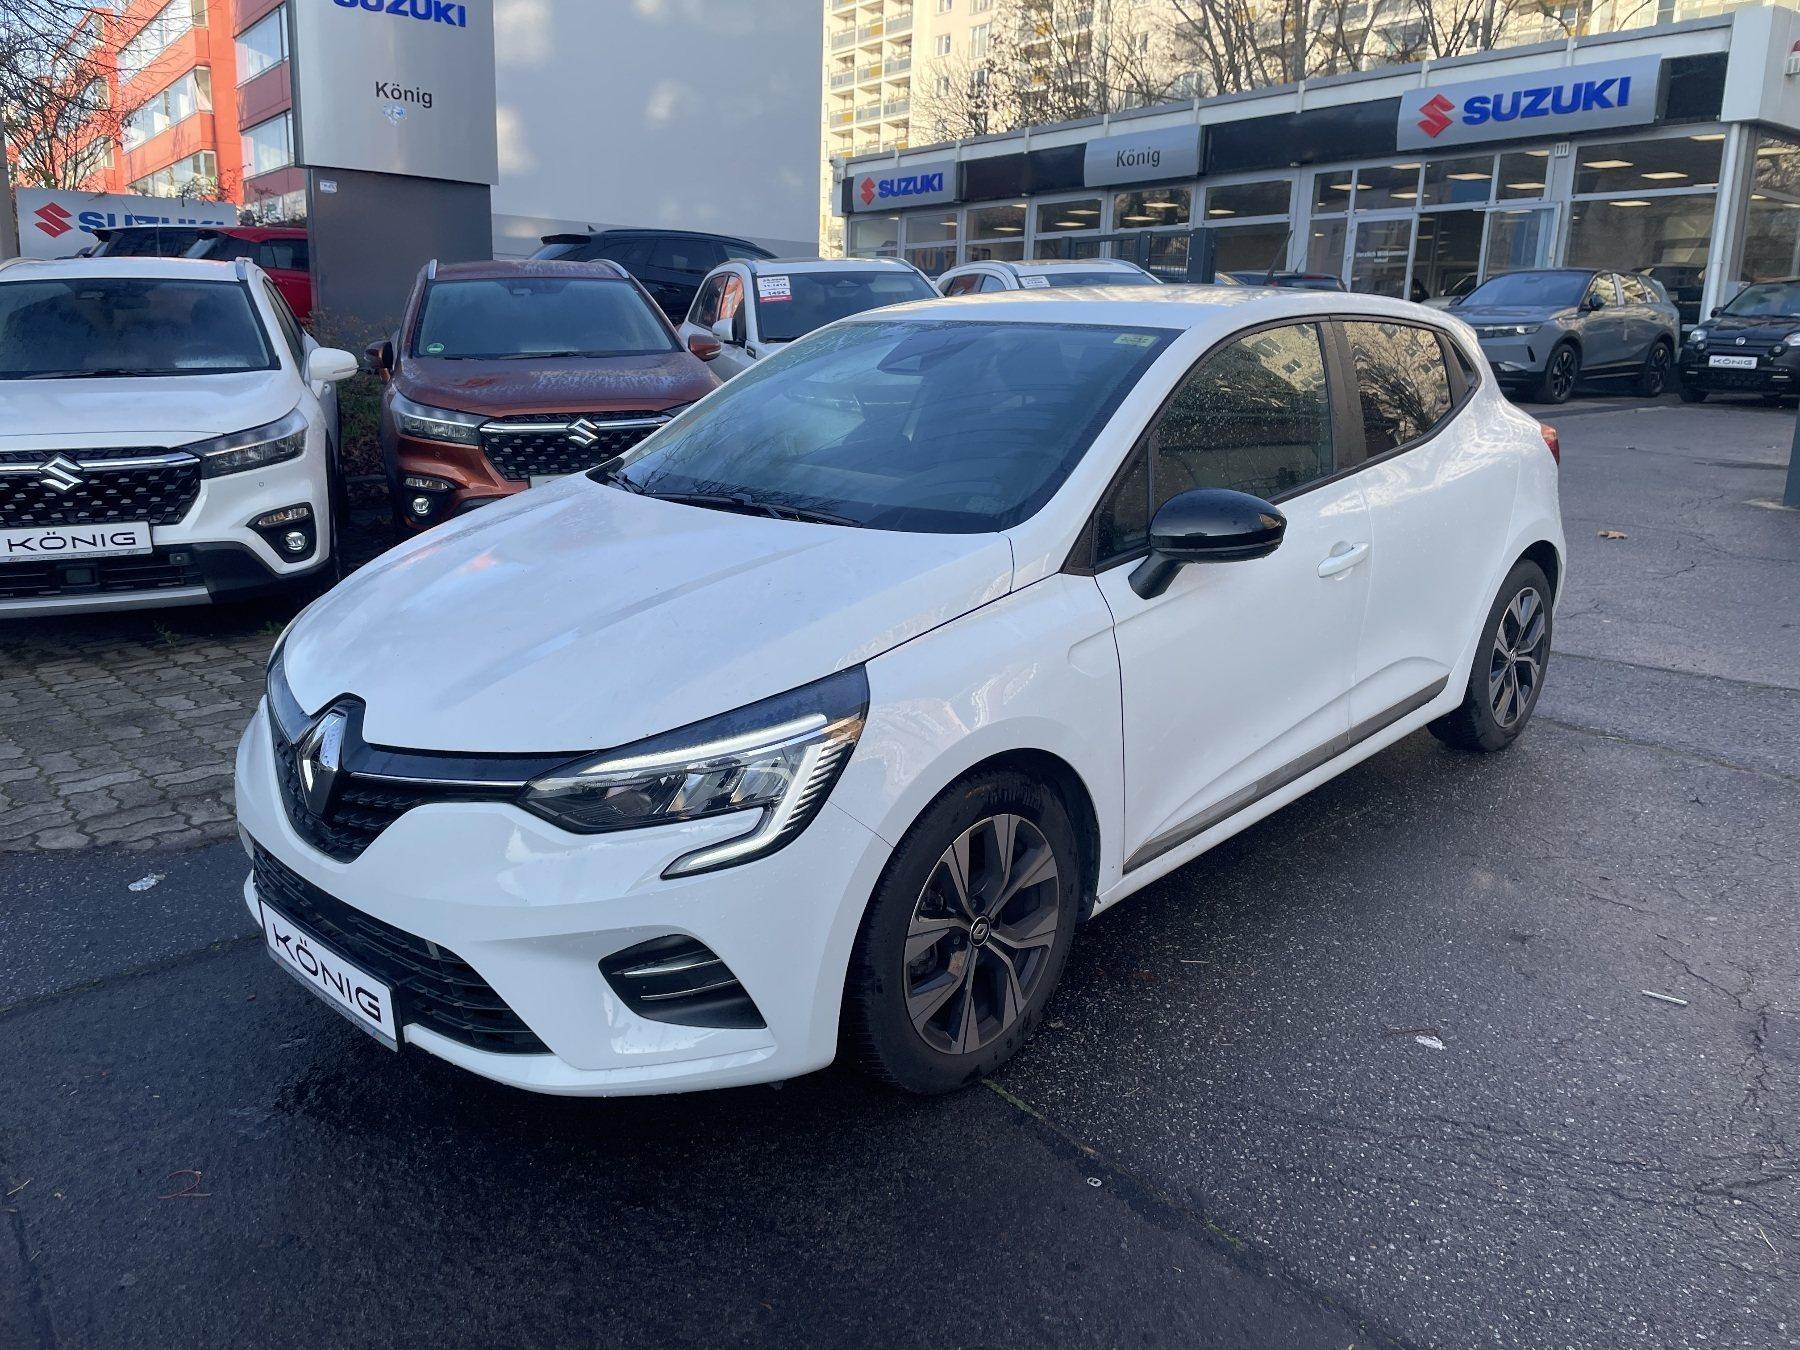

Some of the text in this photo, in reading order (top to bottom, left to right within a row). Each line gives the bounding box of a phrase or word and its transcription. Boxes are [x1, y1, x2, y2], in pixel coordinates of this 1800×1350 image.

[375, 81, 433, 109] König
[1462, 76, 1631, 125] SUZUKI
[1116, 146, 1161, 168] König
[878, 172, 944, 199] SUZUKI
[7, 531, 136, 552] KÖNIG
[272, 923, 382, 1024] KÖNIG
